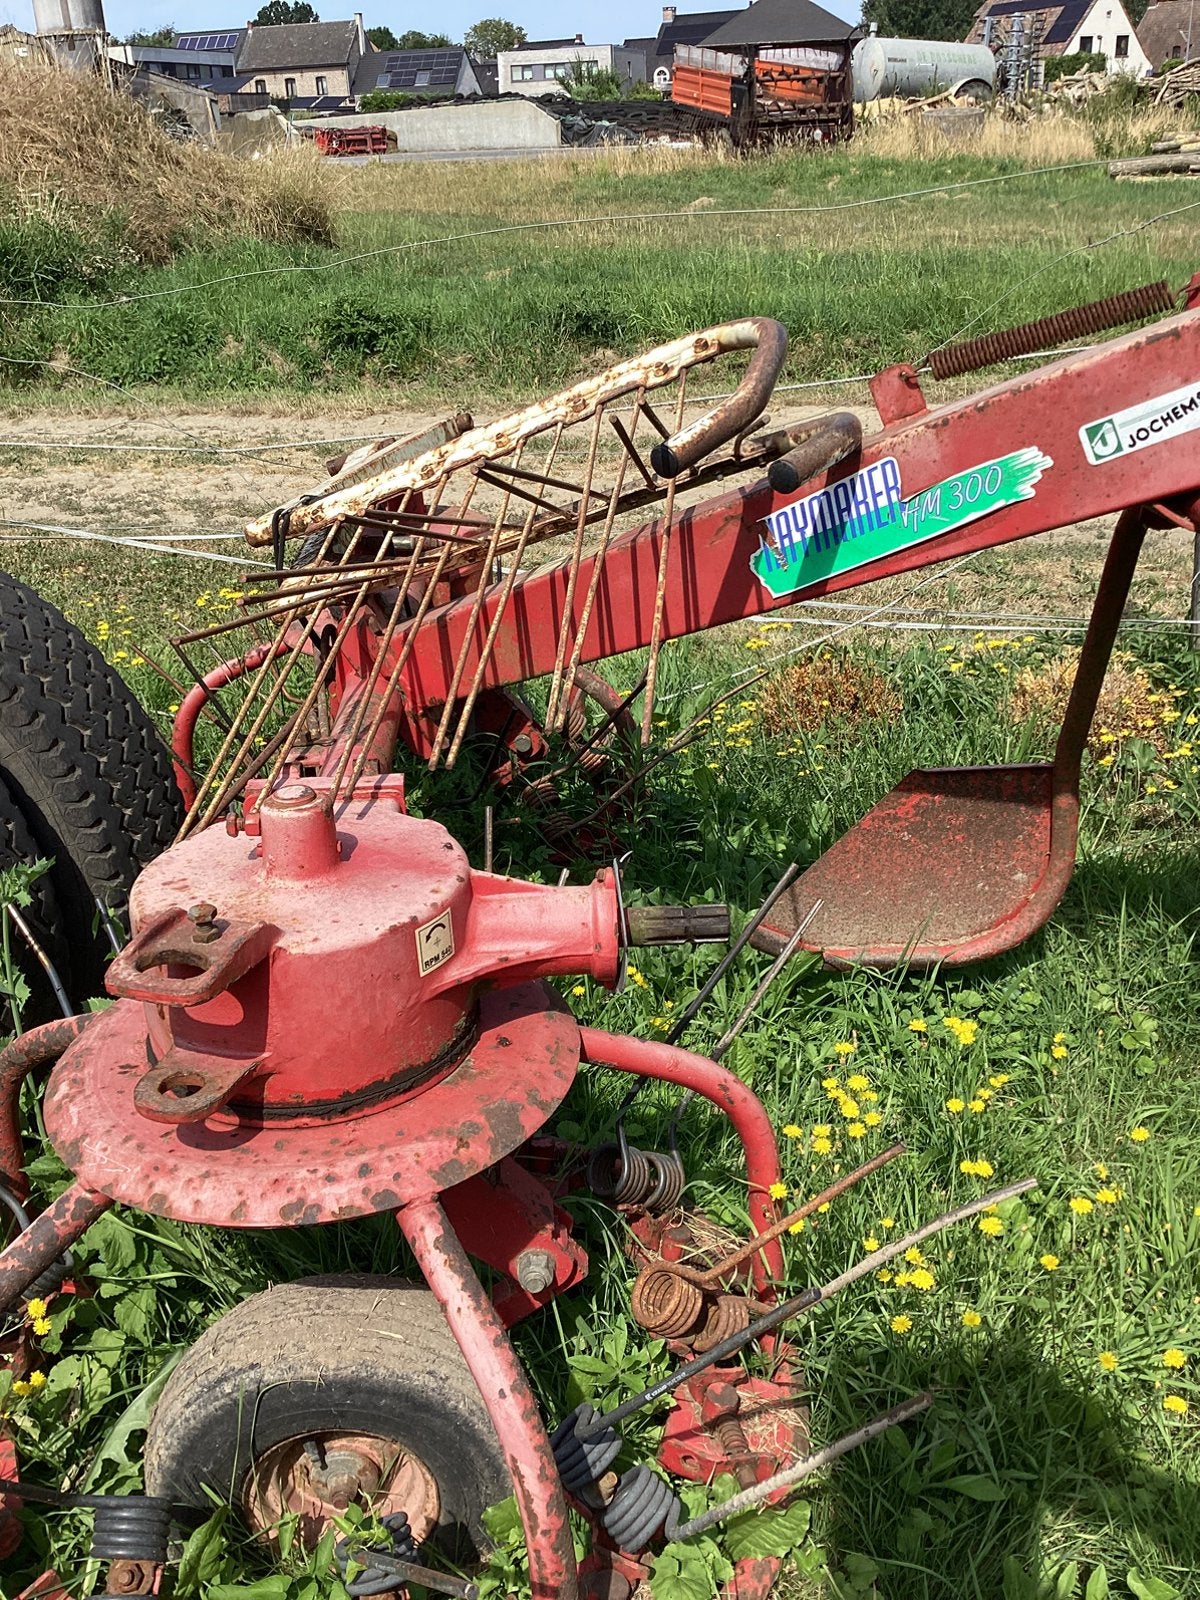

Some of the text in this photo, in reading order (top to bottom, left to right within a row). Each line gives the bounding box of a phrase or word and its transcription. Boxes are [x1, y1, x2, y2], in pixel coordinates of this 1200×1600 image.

[901, 488, 941, 533] HM
[948, 465, 1002, 511] 300
[424, 953, 440, 968] RPM
